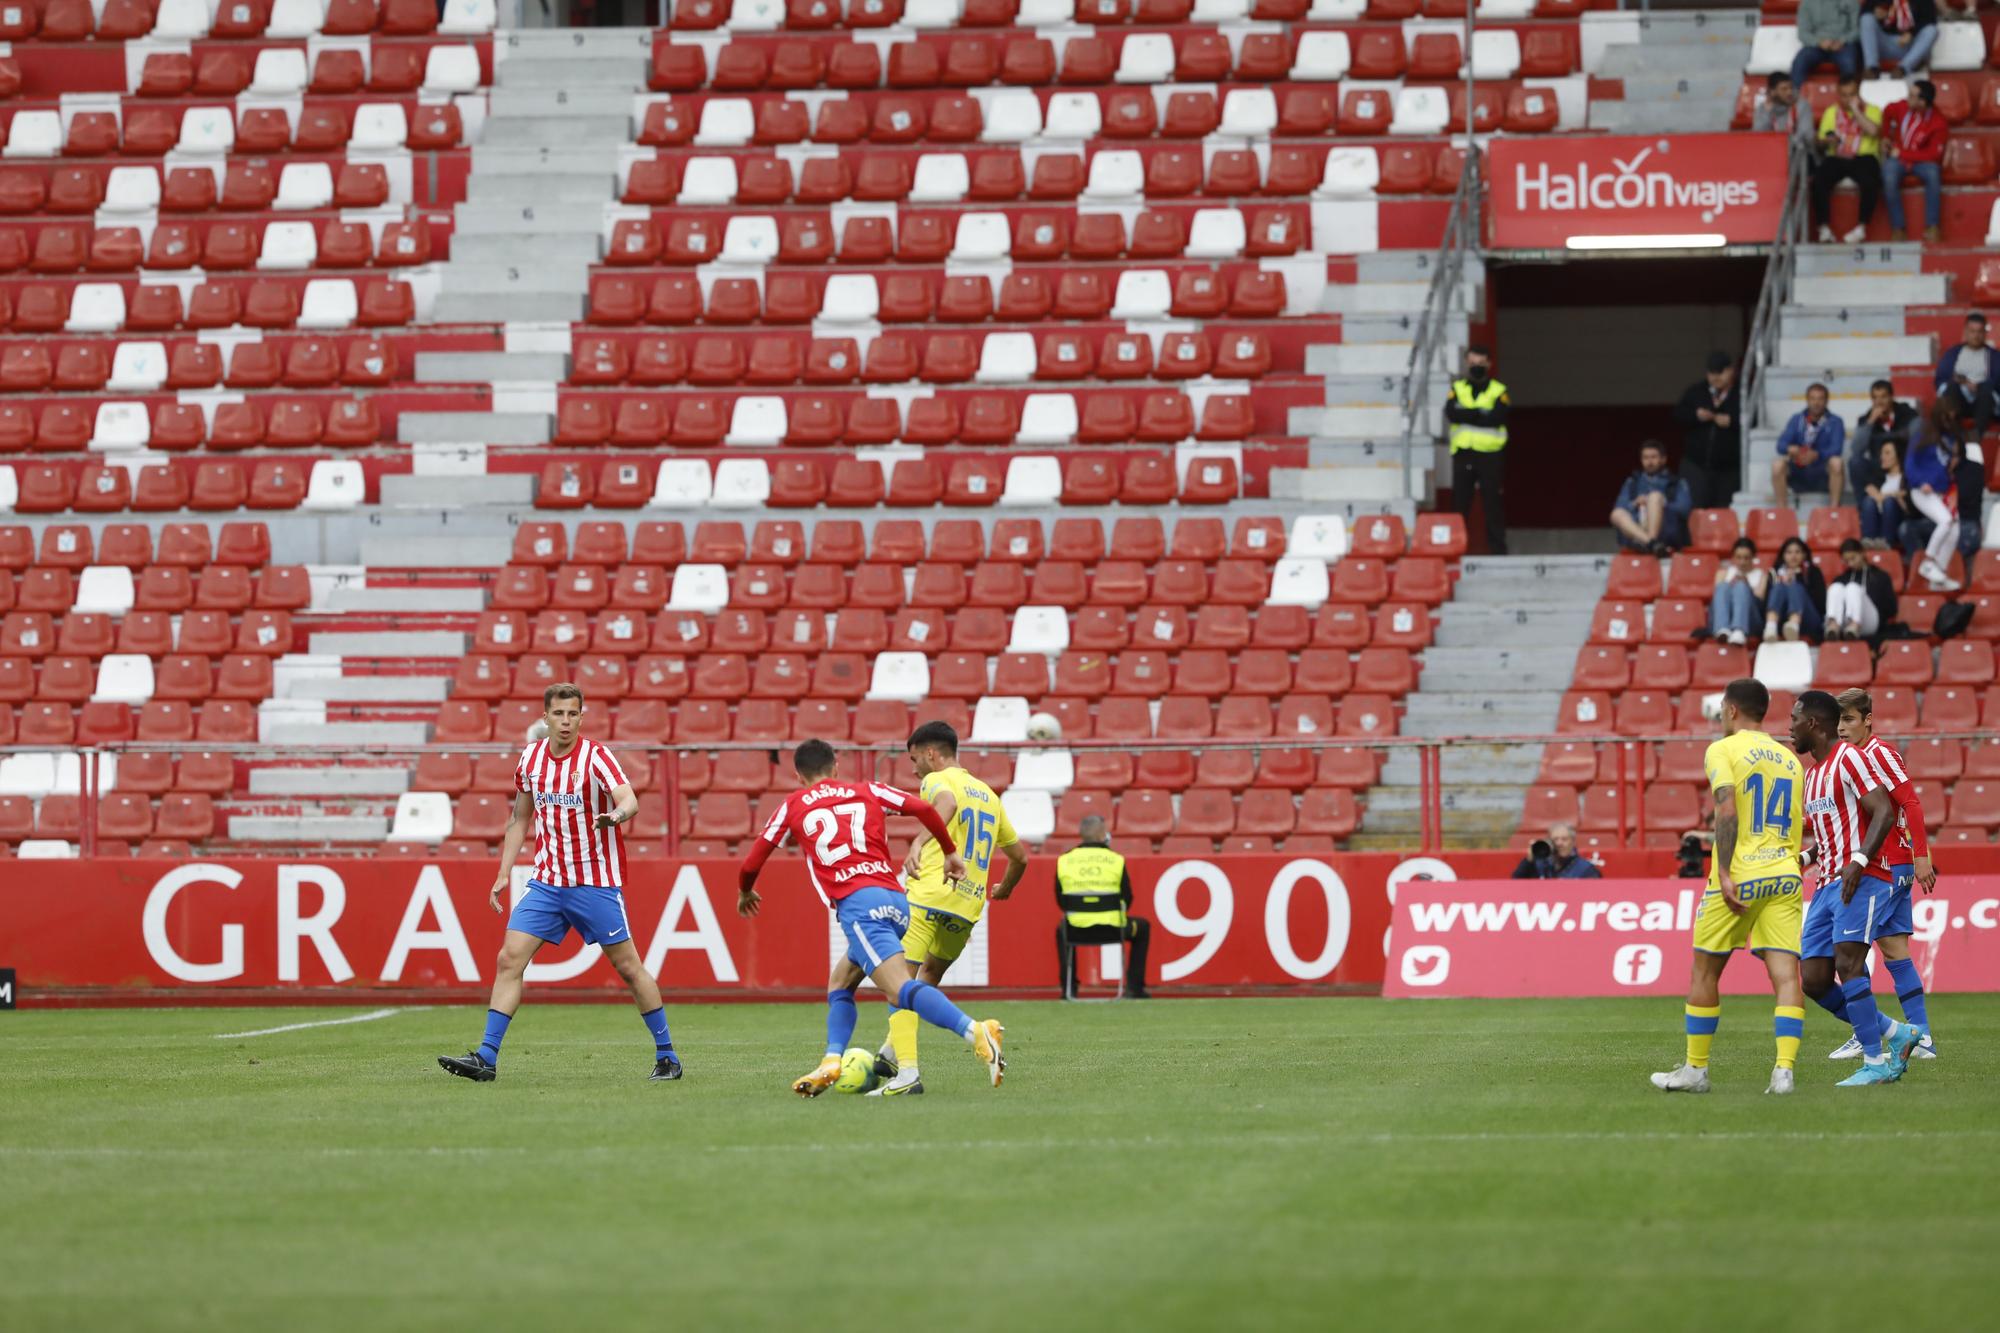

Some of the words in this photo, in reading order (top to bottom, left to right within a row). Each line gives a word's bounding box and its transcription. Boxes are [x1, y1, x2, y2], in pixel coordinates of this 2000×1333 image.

[1743, 747, 1783, 766] LEMOS
[545, 793, 583, 806] INTEGRA
[1743, 773, 1793, 839] 14
[802, 802, 867, 866] 27
[960, 807, 995, 870] 15
[1739, 878, 1801, 901] Binter
[868, 905, 909, 929] NISSA
[1101, 857, 1458, 982] 90
